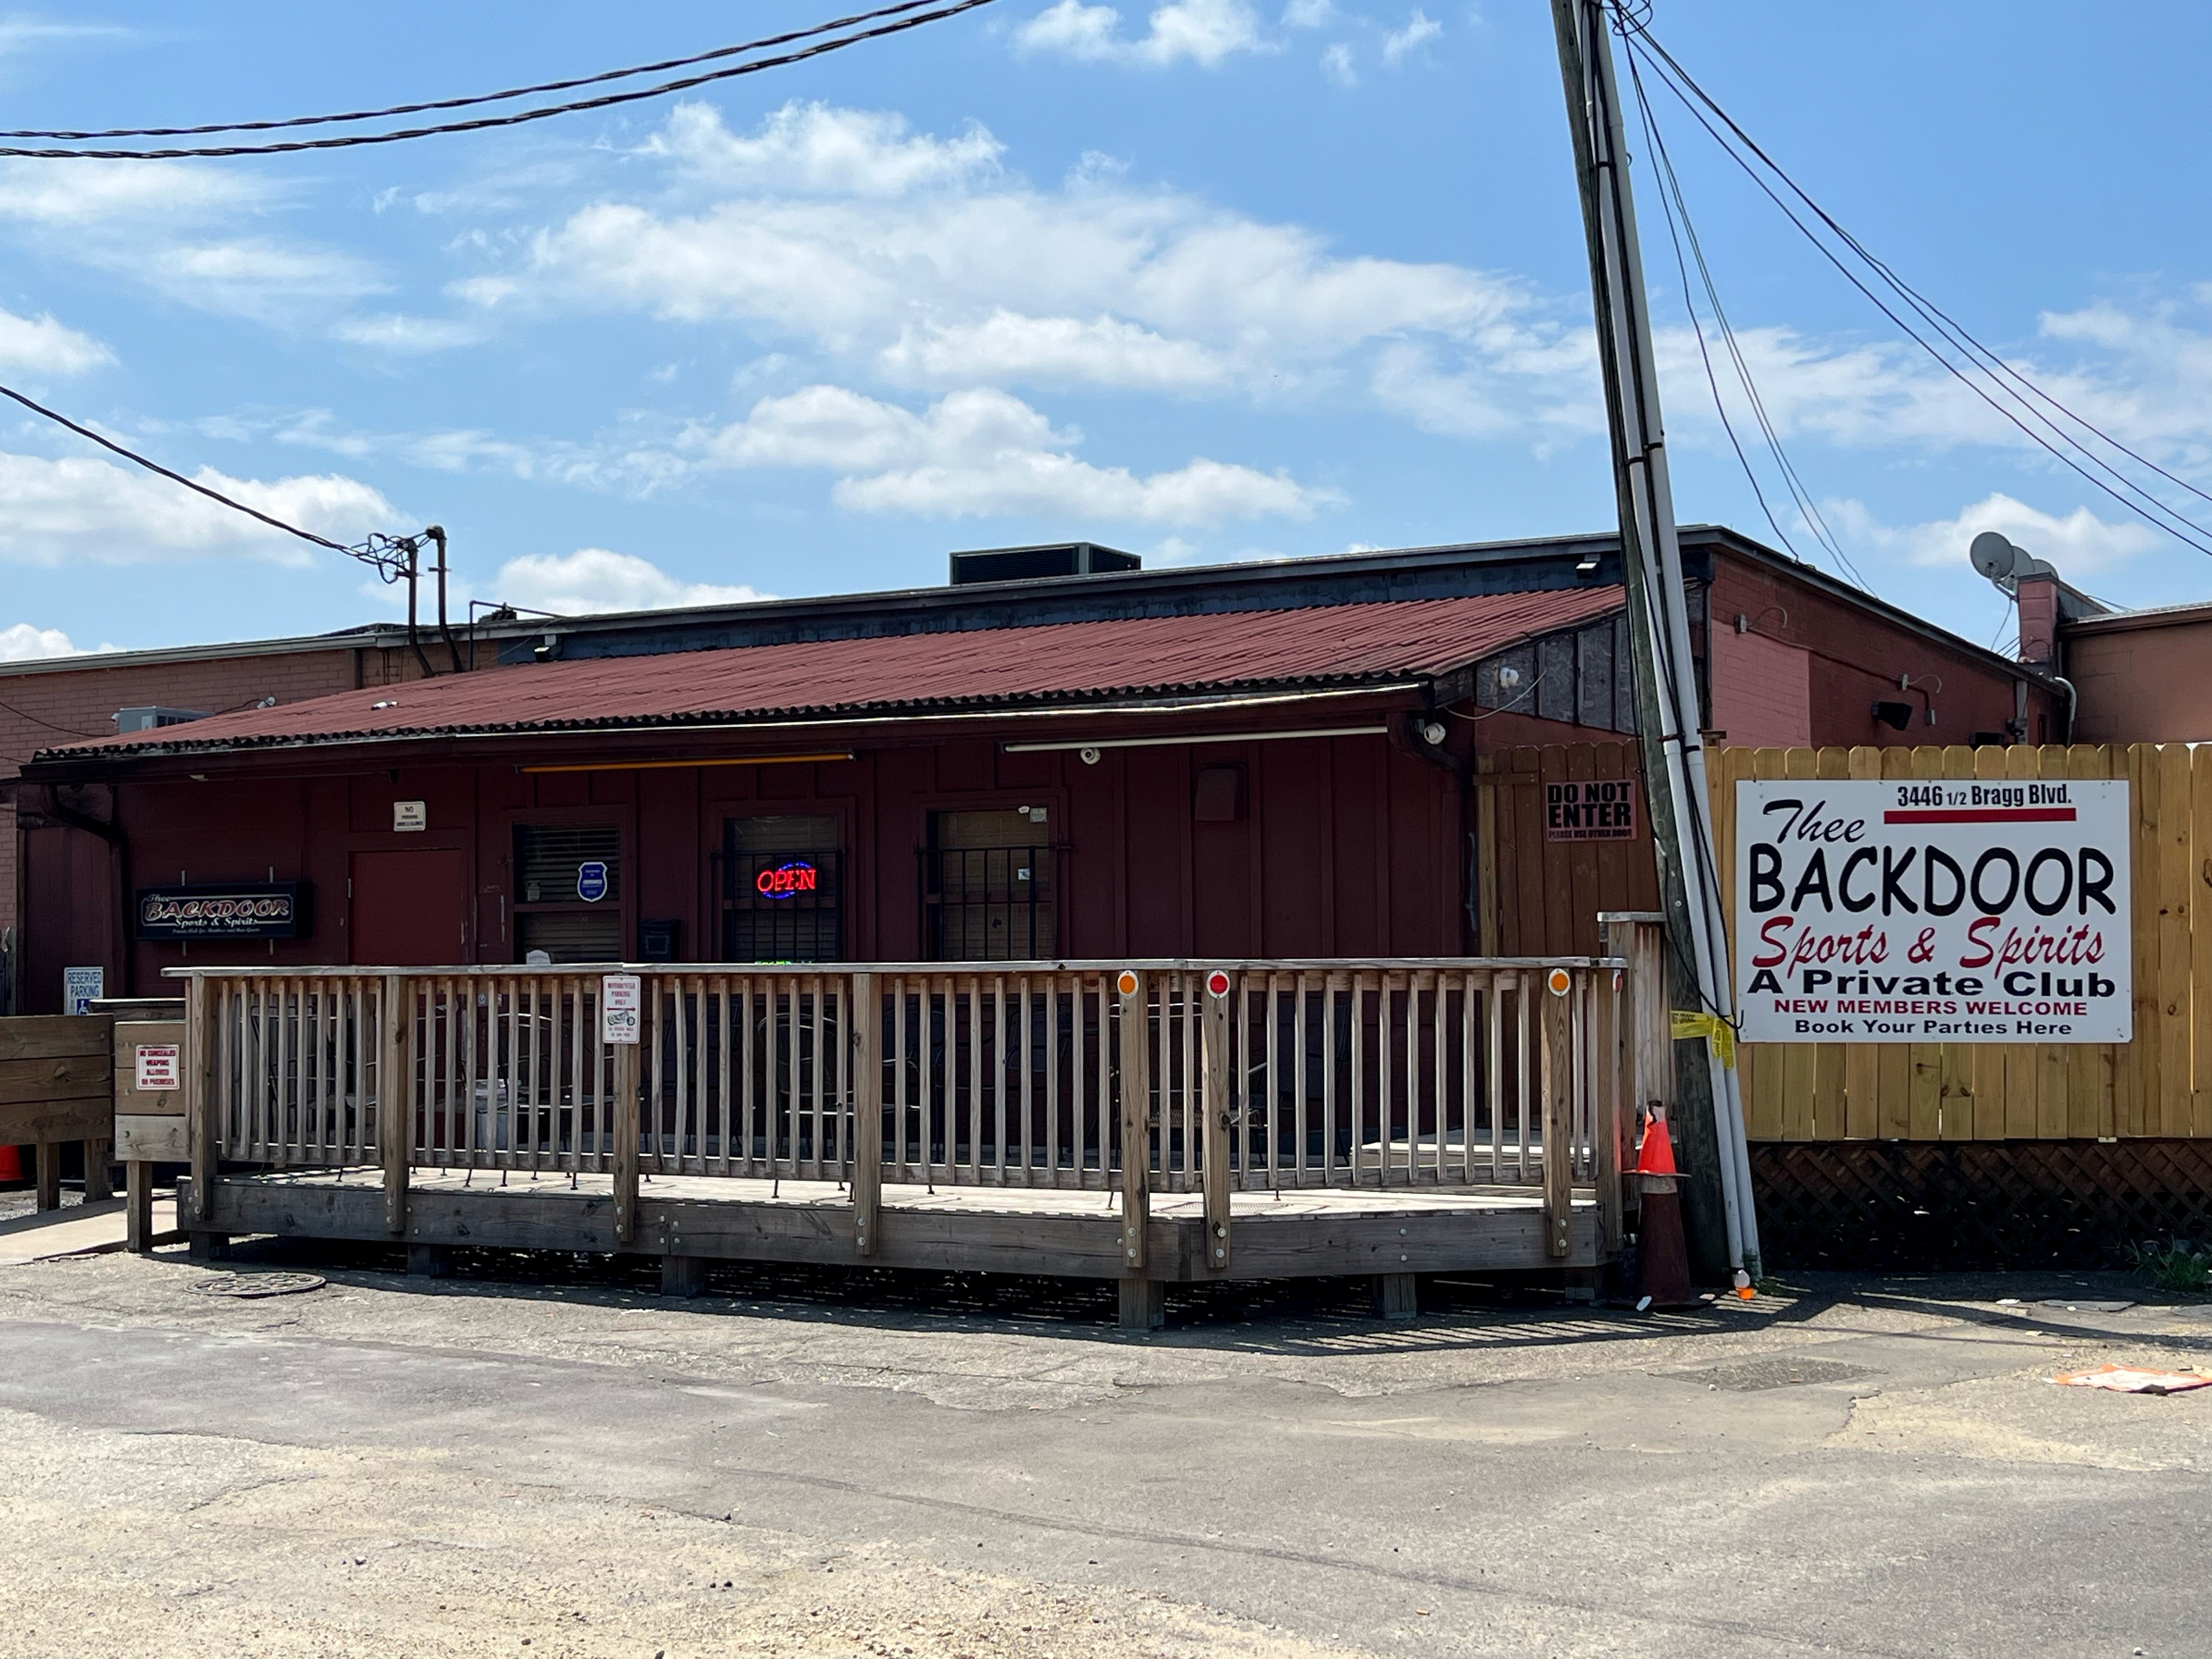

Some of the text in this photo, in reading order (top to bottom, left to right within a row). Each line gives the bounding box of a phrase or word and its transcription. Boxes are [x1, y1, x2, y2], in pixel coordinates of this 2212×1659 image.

[1548, 782, 1631, 803] DO NOT
[1897, 783, 2072, 808] 3446 1/2 Bragg Blvd.
[1548, 802, 1632, 828] ENTER
[1762, 799, 1865, 844] Thee
[1549, 828, 1632, 839] PLEASE USE OTHER DOOR
[757, 869, 816, 892] OPEN
[1749, 843, 2117, 917] BACKDOOR
[148, 894, 171, 902] Thee
[144, 899, 289, 922] BACKDOOR
[176, 917, 258, 928] Sports & Spirits
[1752, 916, 2105, 979] Sports & Spirits
[68, 972, 102, 984] RESERVED
[1747, 969, 2115, 997] A Private Club
[70, 985, 99, 997] PARKING
[1774, 1000, 2087, 1015] NEW MEMBERS WELCOME
[1795, 1019, 2072, 1035] Book Your Parties Here
